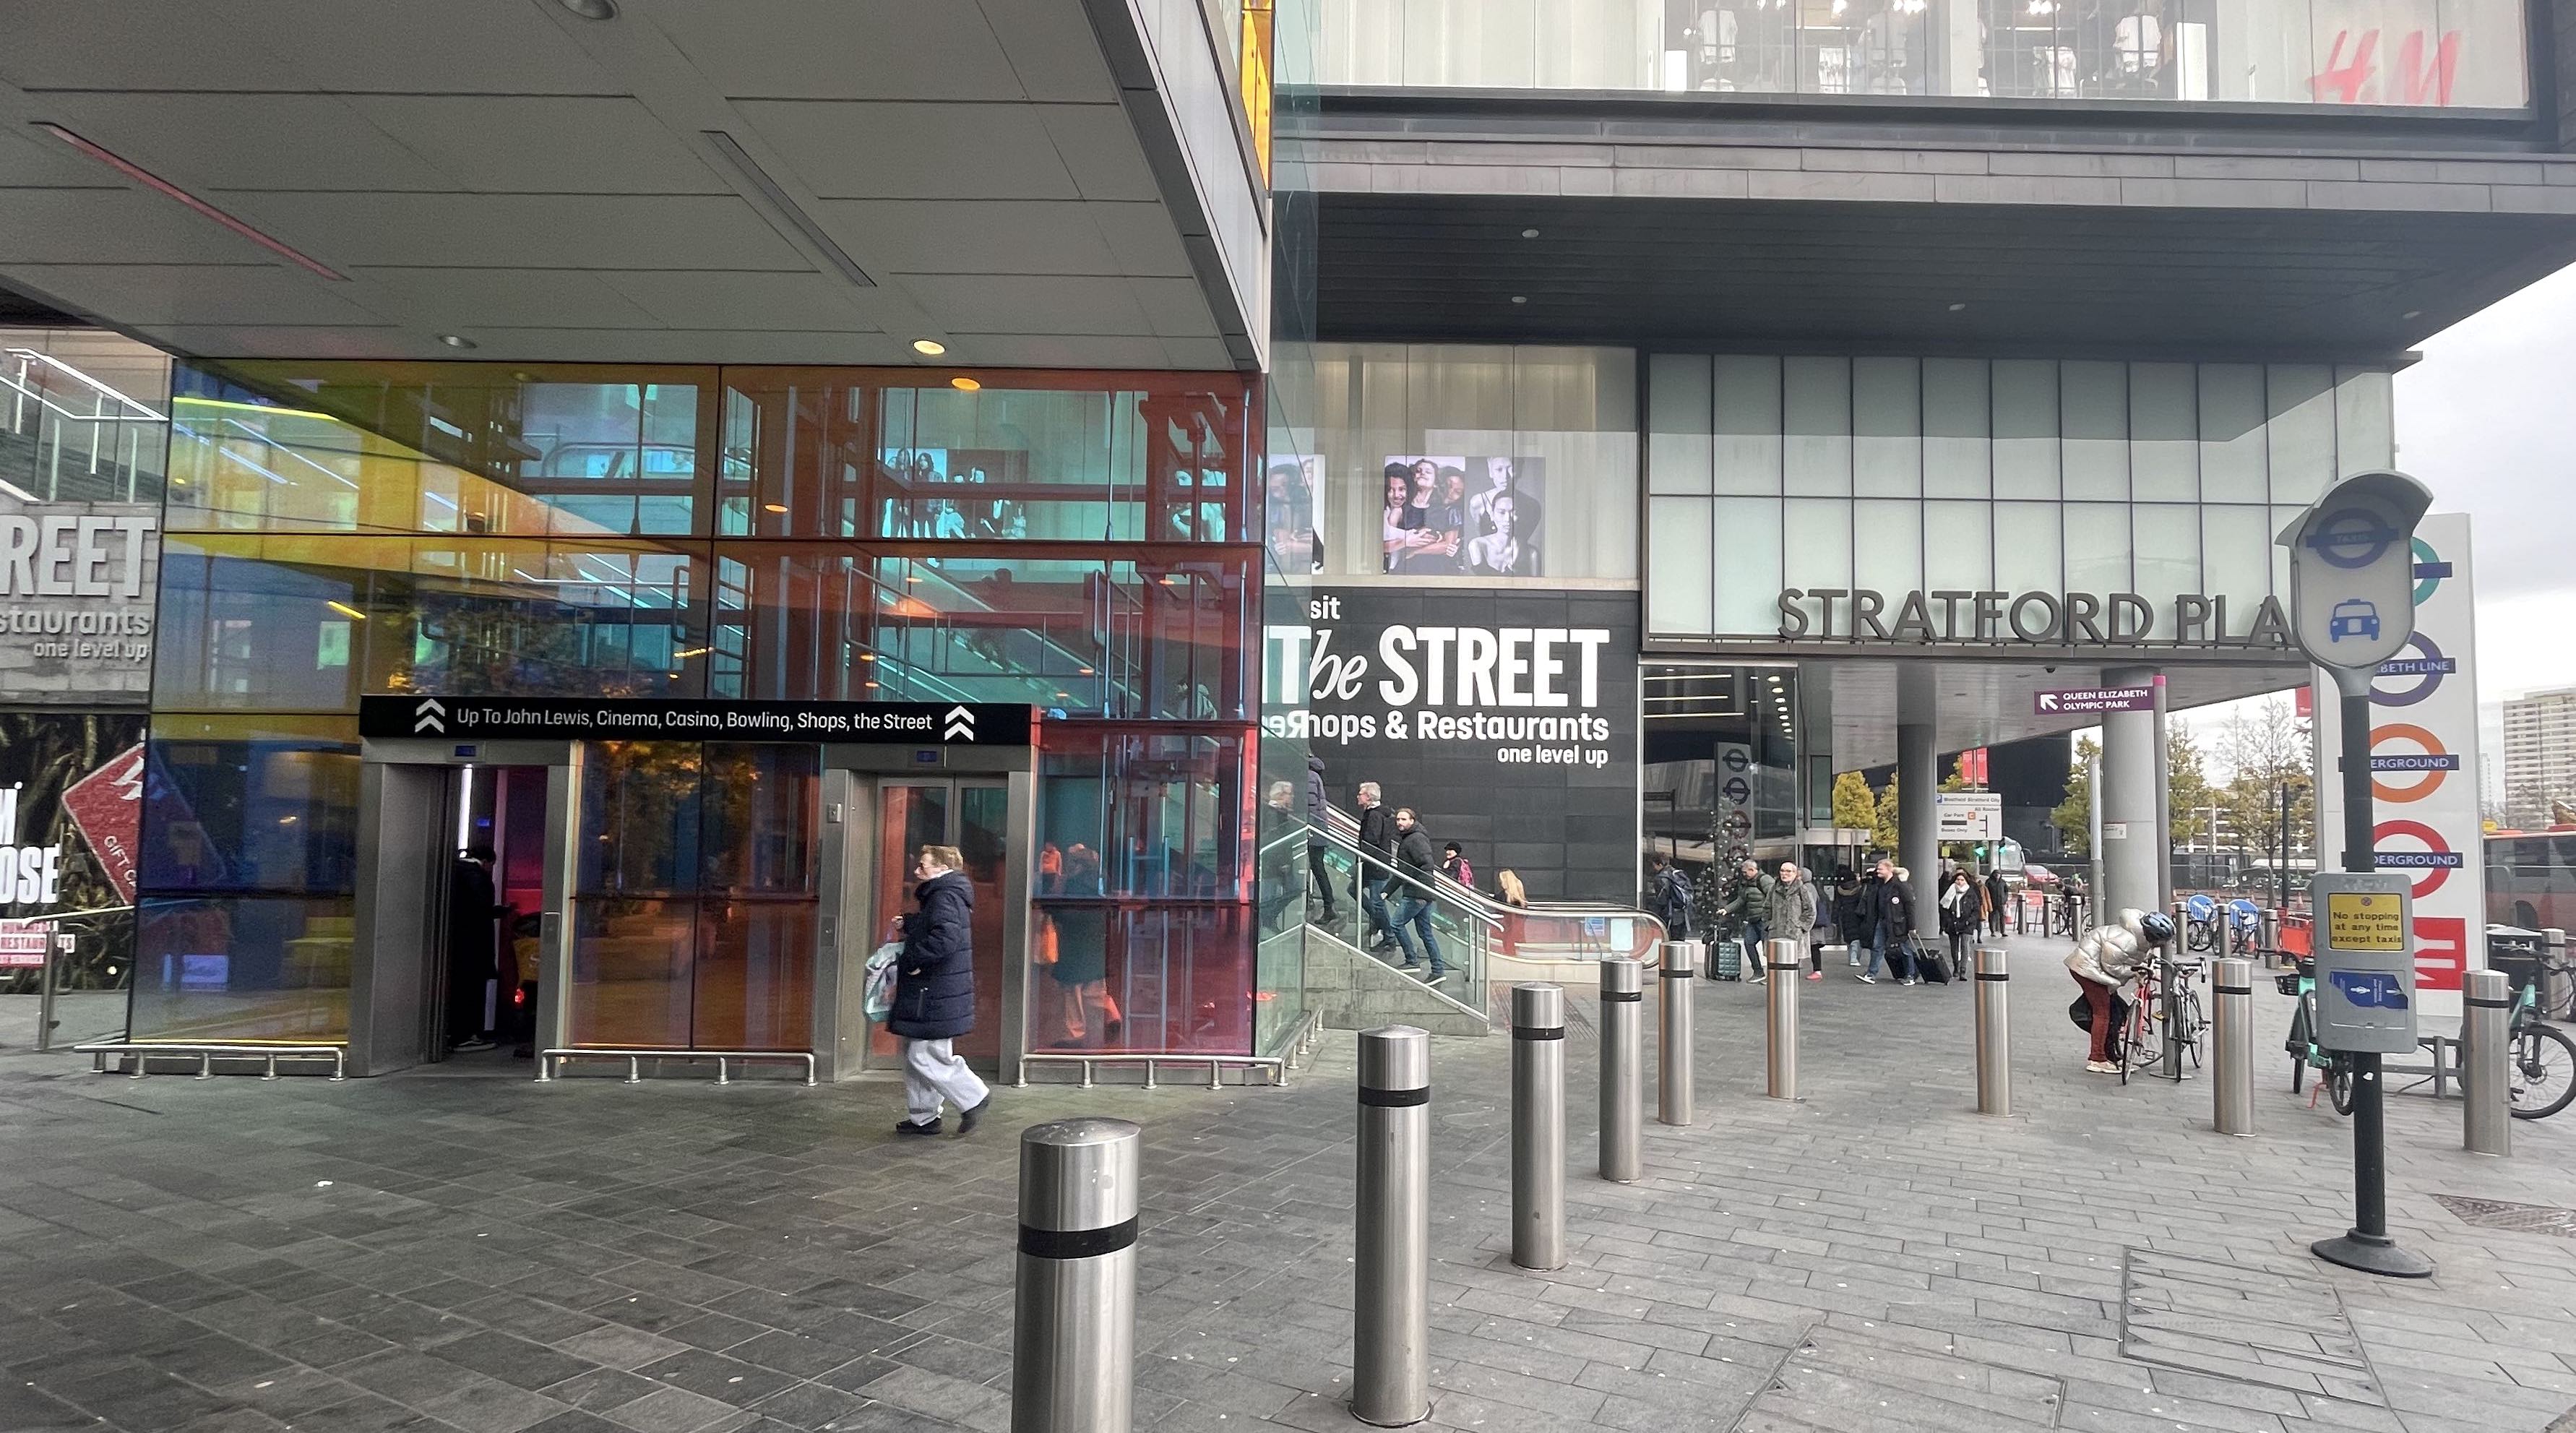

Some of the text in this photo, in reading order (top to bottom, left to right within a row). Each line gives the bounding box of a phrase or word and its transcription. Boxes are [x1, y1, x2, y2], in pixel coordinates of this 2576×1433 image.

[0, 515, 156, 597] REET
[1310, 595, 1341, 619] sit
[1777, 588, 2293, 645] STRATFORD PLA
[34, 639, 150, 662] one level up
[1379, 624, 1610, 708] STREET
[2377, 660, 2450, 674] BETH LINE
[2063, 689, 2148, 700] QUEEN ELIZABETH
[2063, 700, 2130, 710] OLYMPIC PARK
[457, 708, 932, 732] Up To John Lewis, Cinema, Casino, Bowling, Shops, the Street
[1384, 709, 1408, 739] &
[1417, 710, 1609, 741] Restaurants
[1496, 744, 1608, 769] one level up
[2370, 757, 2449, 768] ERGROUND
[104, 835, 130, 866] GIFT
[0, 845, 59, 903] OSE
[2332, 911, 2400, 921] No stopping
[2351, 924, 2371, 932] any
[2331, 935, 2371, 944] except
